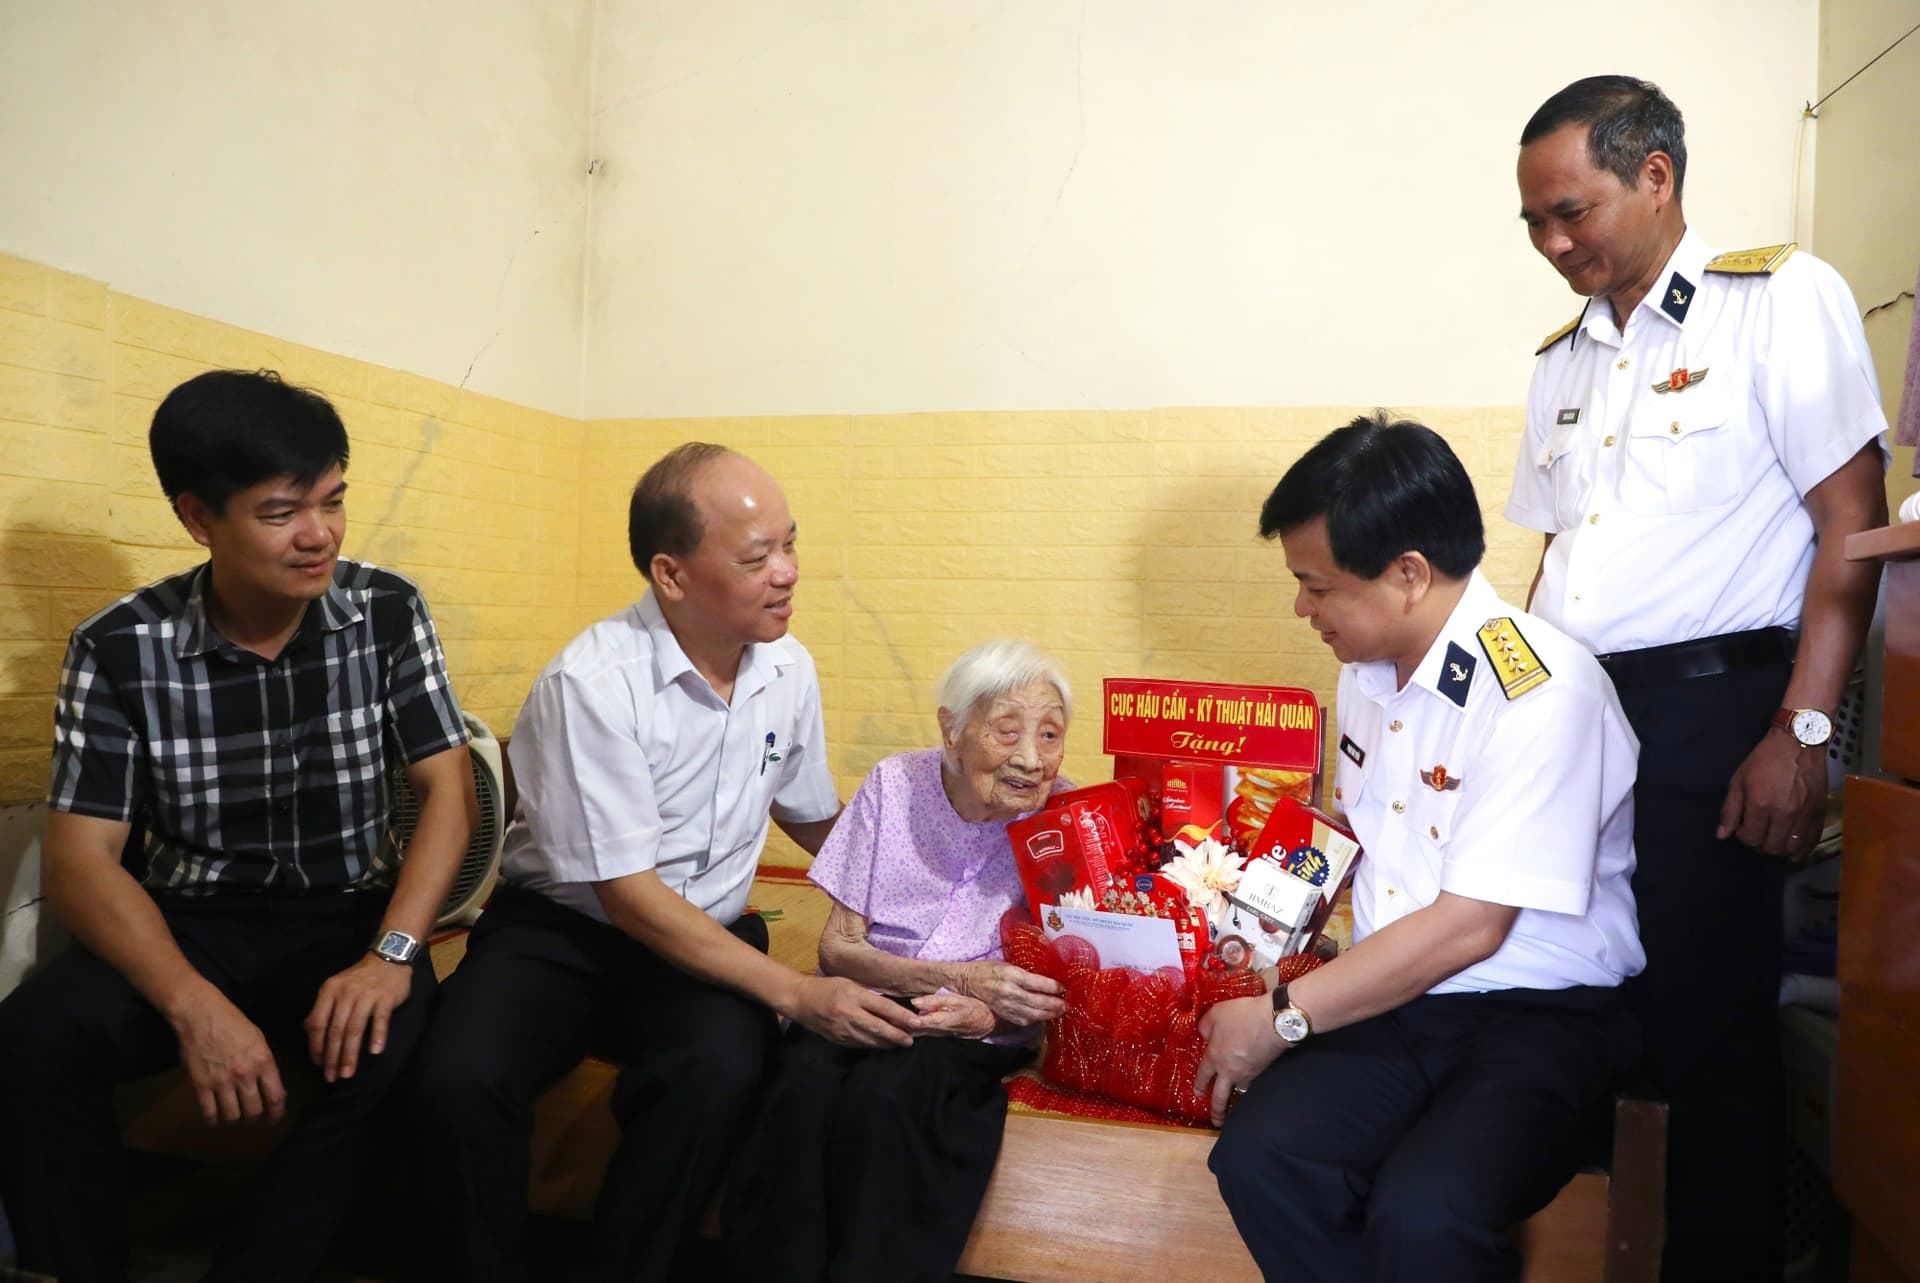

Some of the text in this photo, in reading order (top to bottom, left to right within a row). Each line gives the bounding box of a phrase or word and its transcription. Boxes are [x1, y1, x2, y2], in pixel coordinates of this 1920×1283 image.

[1111, 692, 1134, 721] CỤC
[1136, 689, 1160, 723] HẬU
[1162, 688, 1187, 721] CẦN
[1197, 694, 1213, 722] KỸ
[1216, 696, 1254, 730] THUẬT
[1255, 692, 1277, 727] HẢI
[1279, 700, 1314, 731] QUÂN
[1170, 731, 1247, 756] Tặng!
